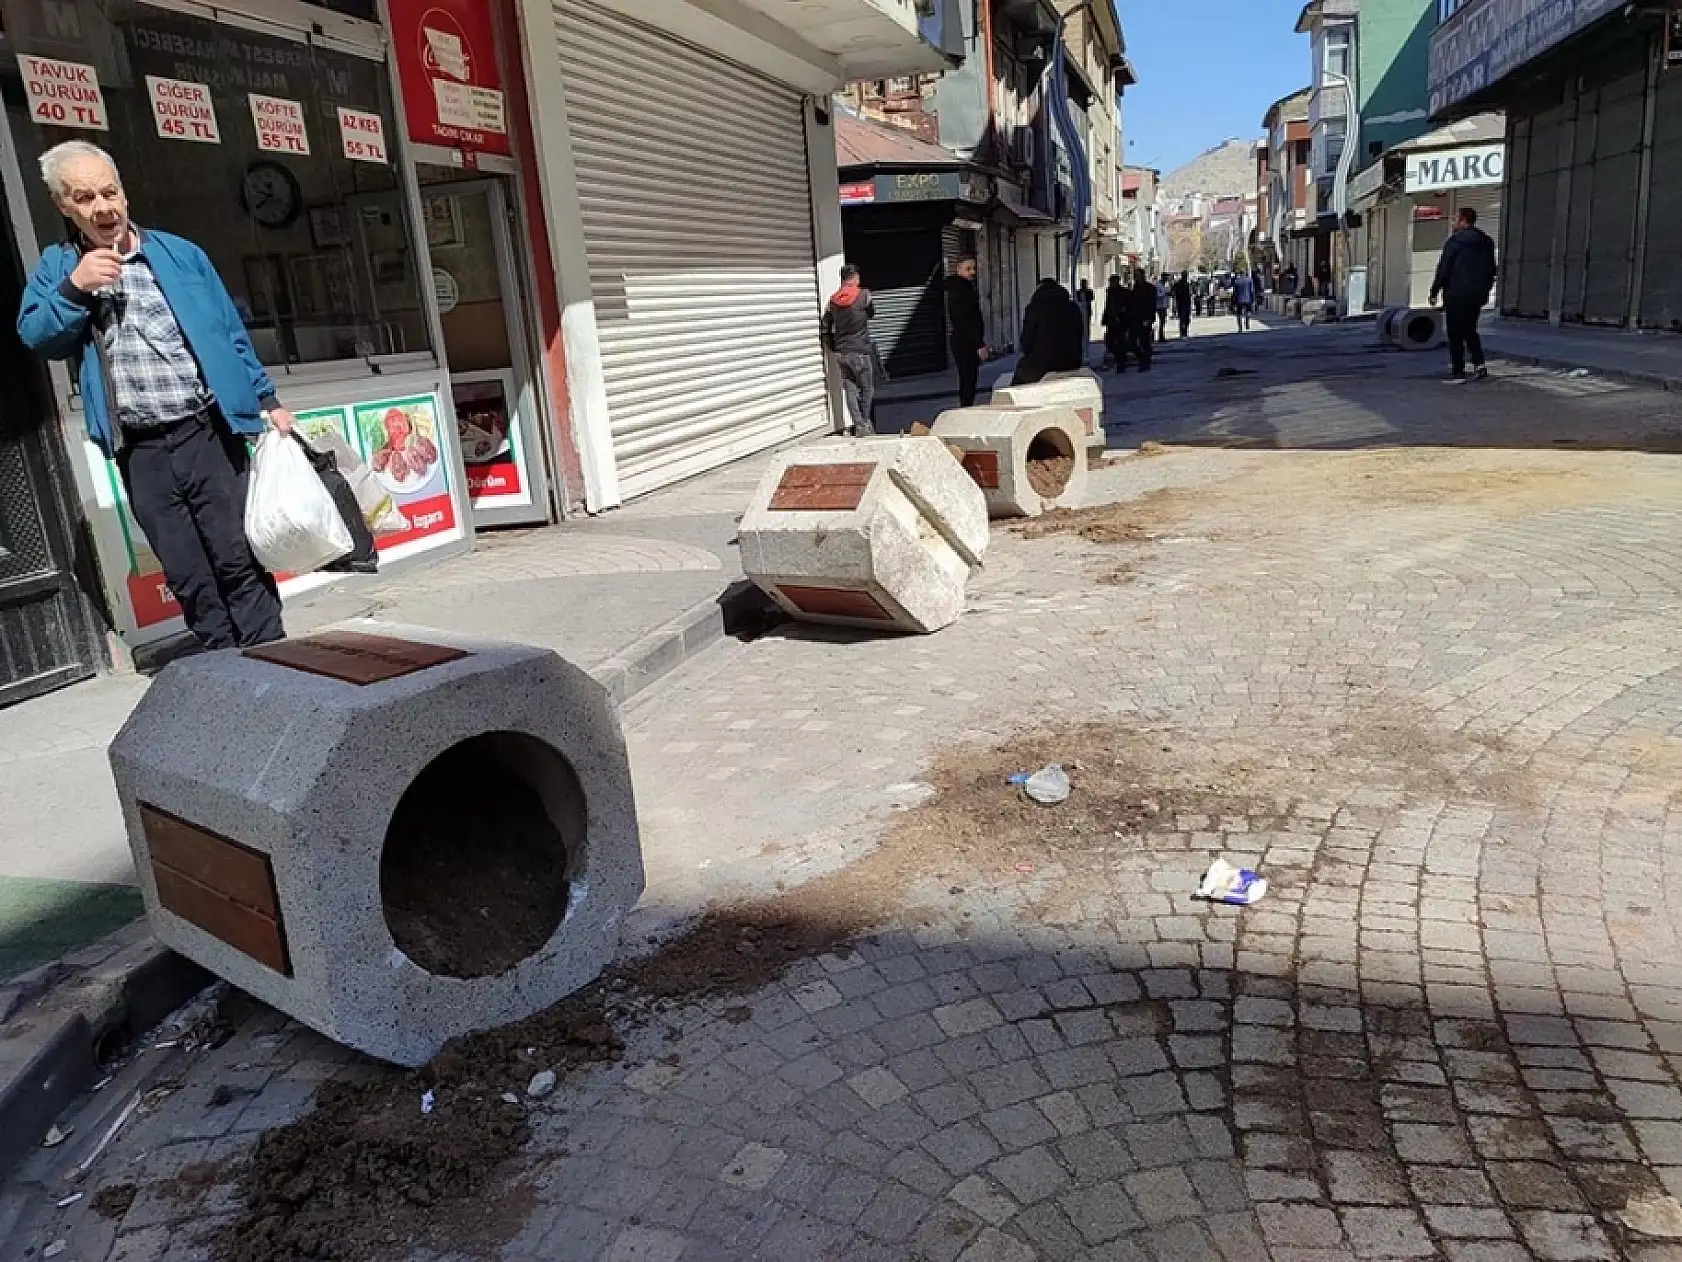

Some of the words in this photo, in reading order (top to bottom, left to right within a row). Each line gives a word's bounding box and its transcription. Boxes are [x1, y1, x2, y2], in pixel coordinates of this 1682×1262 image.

[28, 60, 89, 83] TAVUK
[29, 80, 99, 103] DÜRÜM
[37, 102, 65, 120] 40
[72, 106, 102, 125] TL
[156, 101, 212, 119] DÜRÜM
[256, 100, 298, 118] KÖFTE
[162, 119, 185, 134] 45
[190, 122, 215, 138] TL
[257, 117, 303, 134] DÜRÜM
[343, 114, 358, 130] AZ
[360, 118, 380, 134] KES
[262, 132, 281, 148] 55
[285, 135, 306, 151] TL
[347, 141, 363, 155] 55
[366, 144, 383, 158] TL
[1418, 152, 1501, 185] MARC
[897, 174, 940, 189] EXPO
